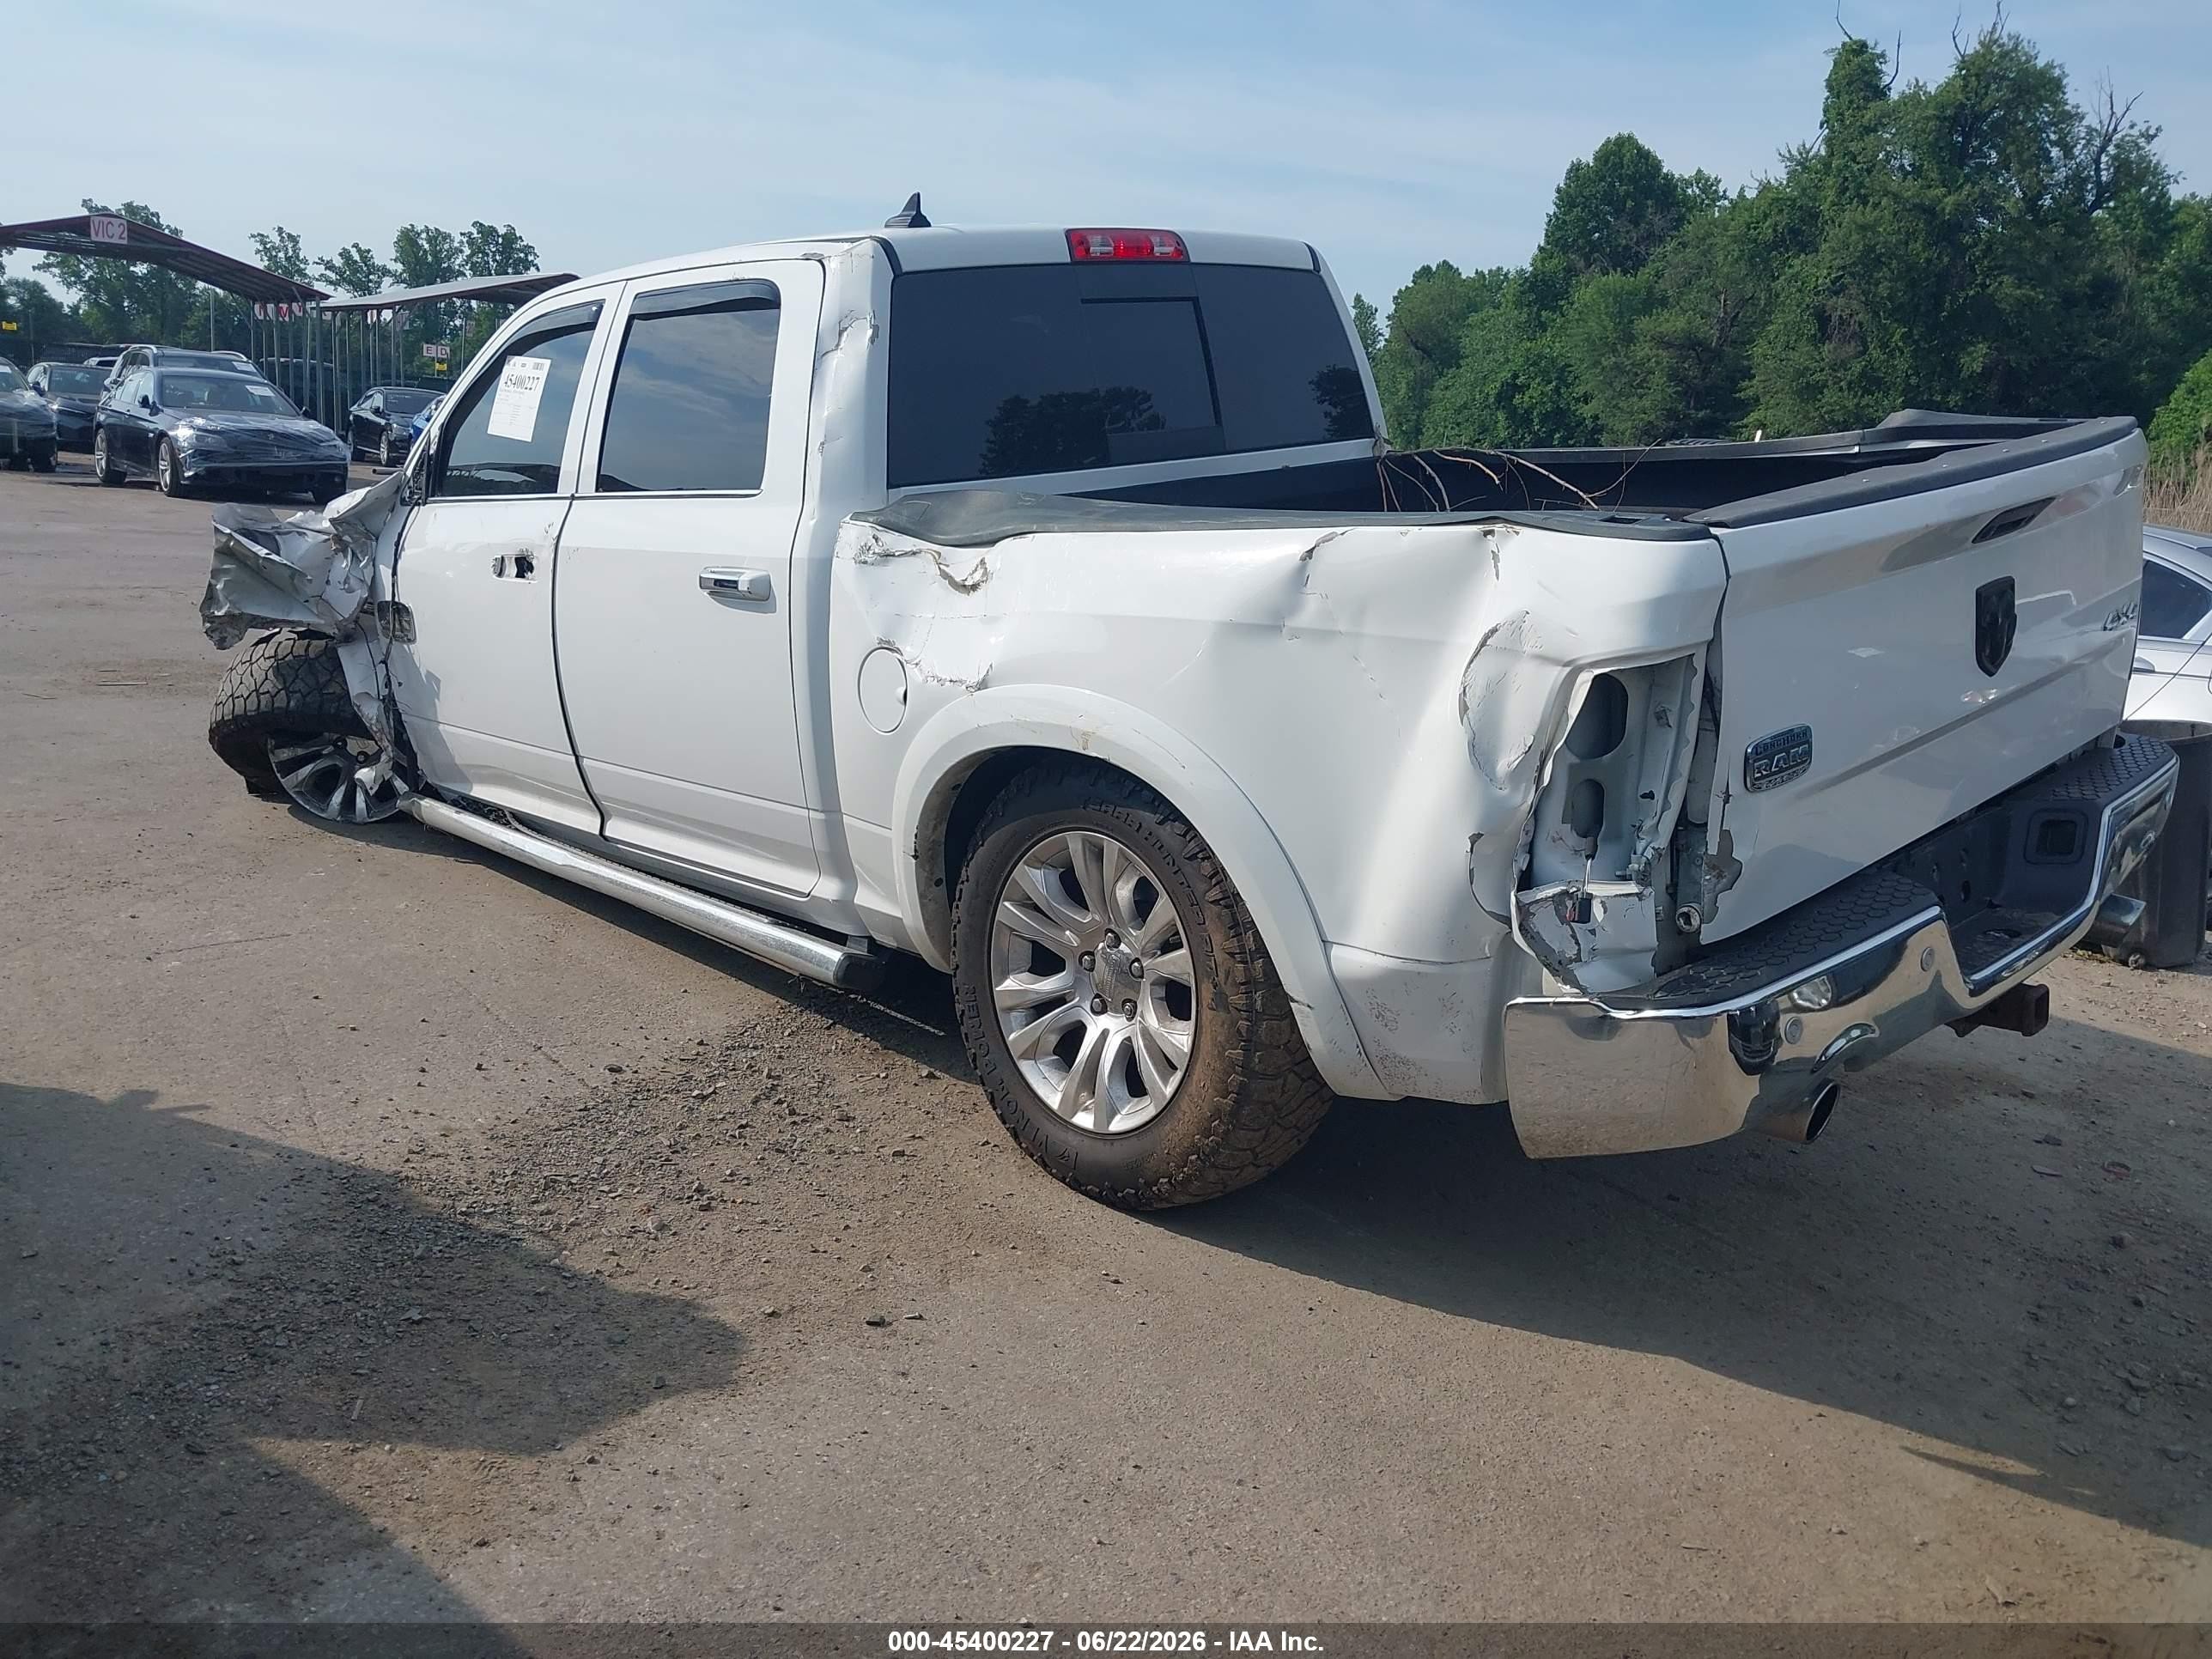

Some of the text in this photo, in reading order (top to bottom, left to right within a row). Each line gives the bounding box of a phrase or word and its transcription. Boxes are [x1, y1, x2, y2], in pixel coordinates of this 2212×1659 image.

[91, 219, 126, 240] VIC 2
[503, 373, 541, 392] 45400227
[1753, 744, 1809, 778] RAM
